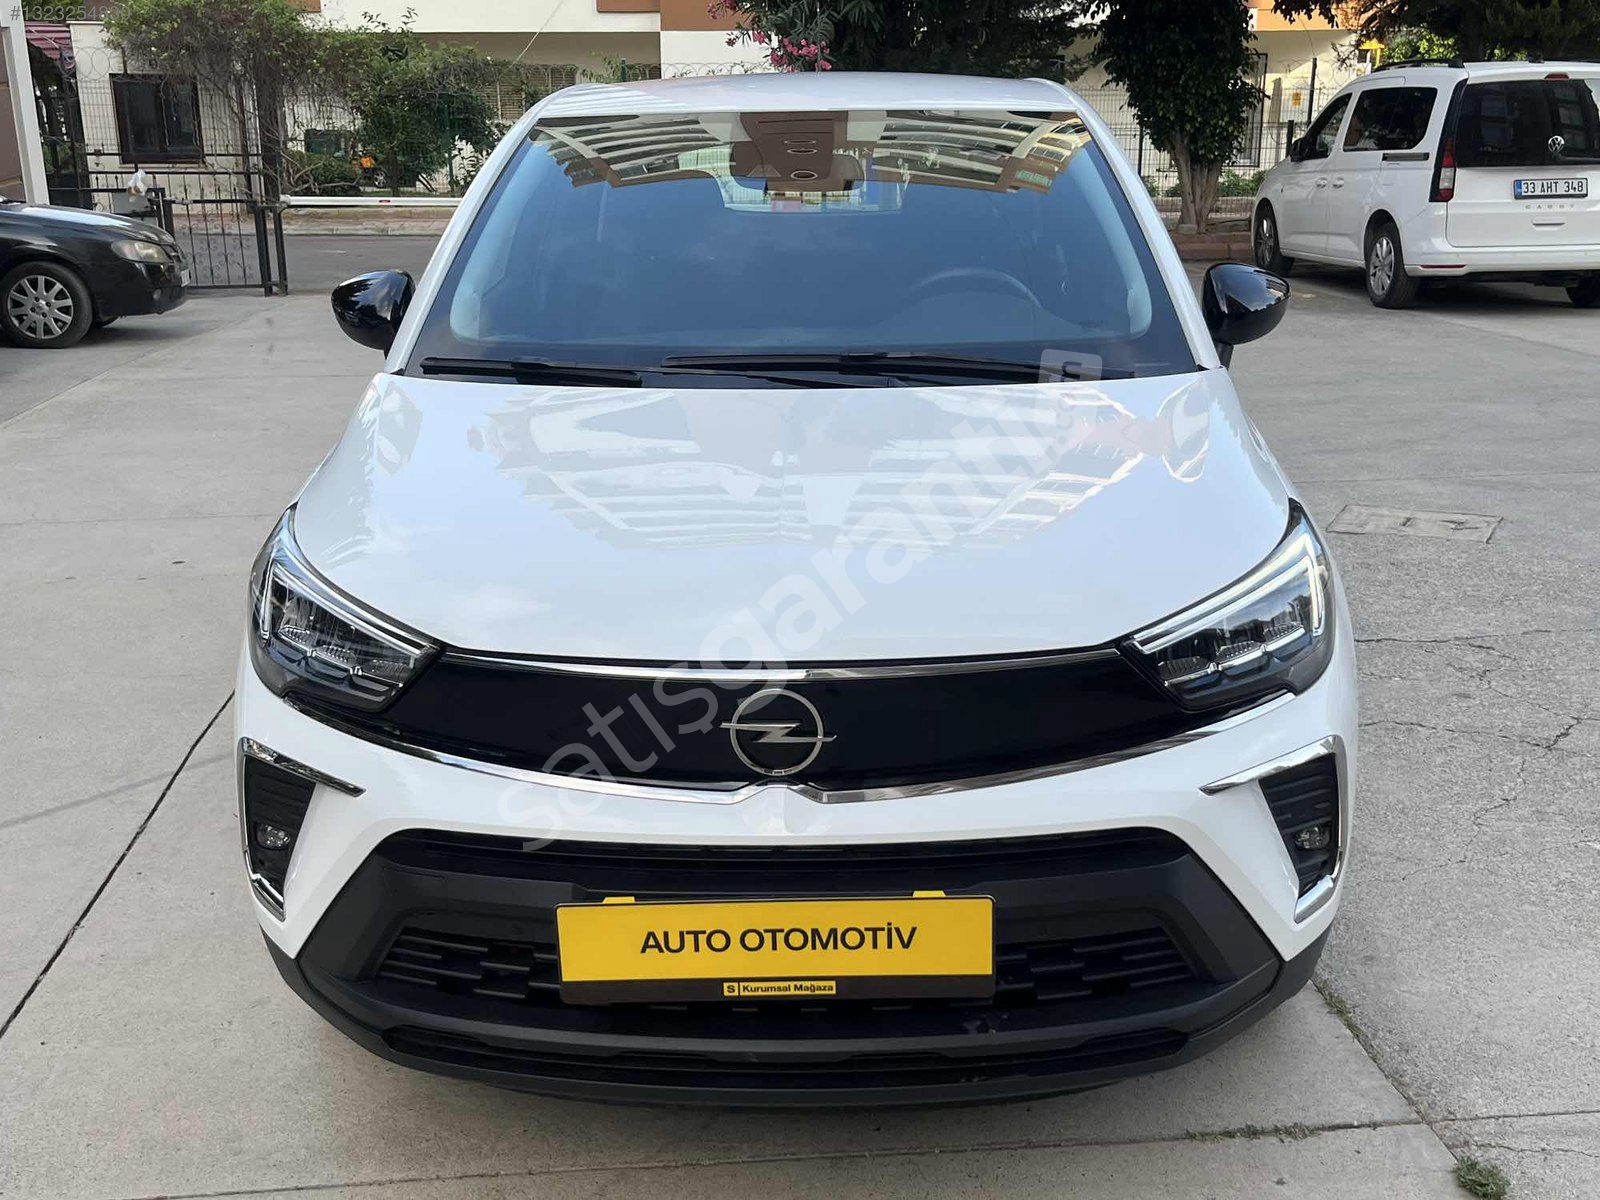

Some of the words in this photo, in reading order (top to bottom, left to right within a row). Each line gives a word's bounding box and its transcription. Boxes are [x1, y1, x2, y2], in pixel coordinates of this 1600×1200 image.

[1523, 182, 1535, 193] 33
[1540, 182, 1558, 192] AHT
[1564, 181, 1583, 192] 348
[640, 929, 731, 954] AUTO
[739, 921, 918, 952] OTOMOTİV
[742, 984, 791, 993] Kurumsal
[793, 983, 834, 994] Mağaza
